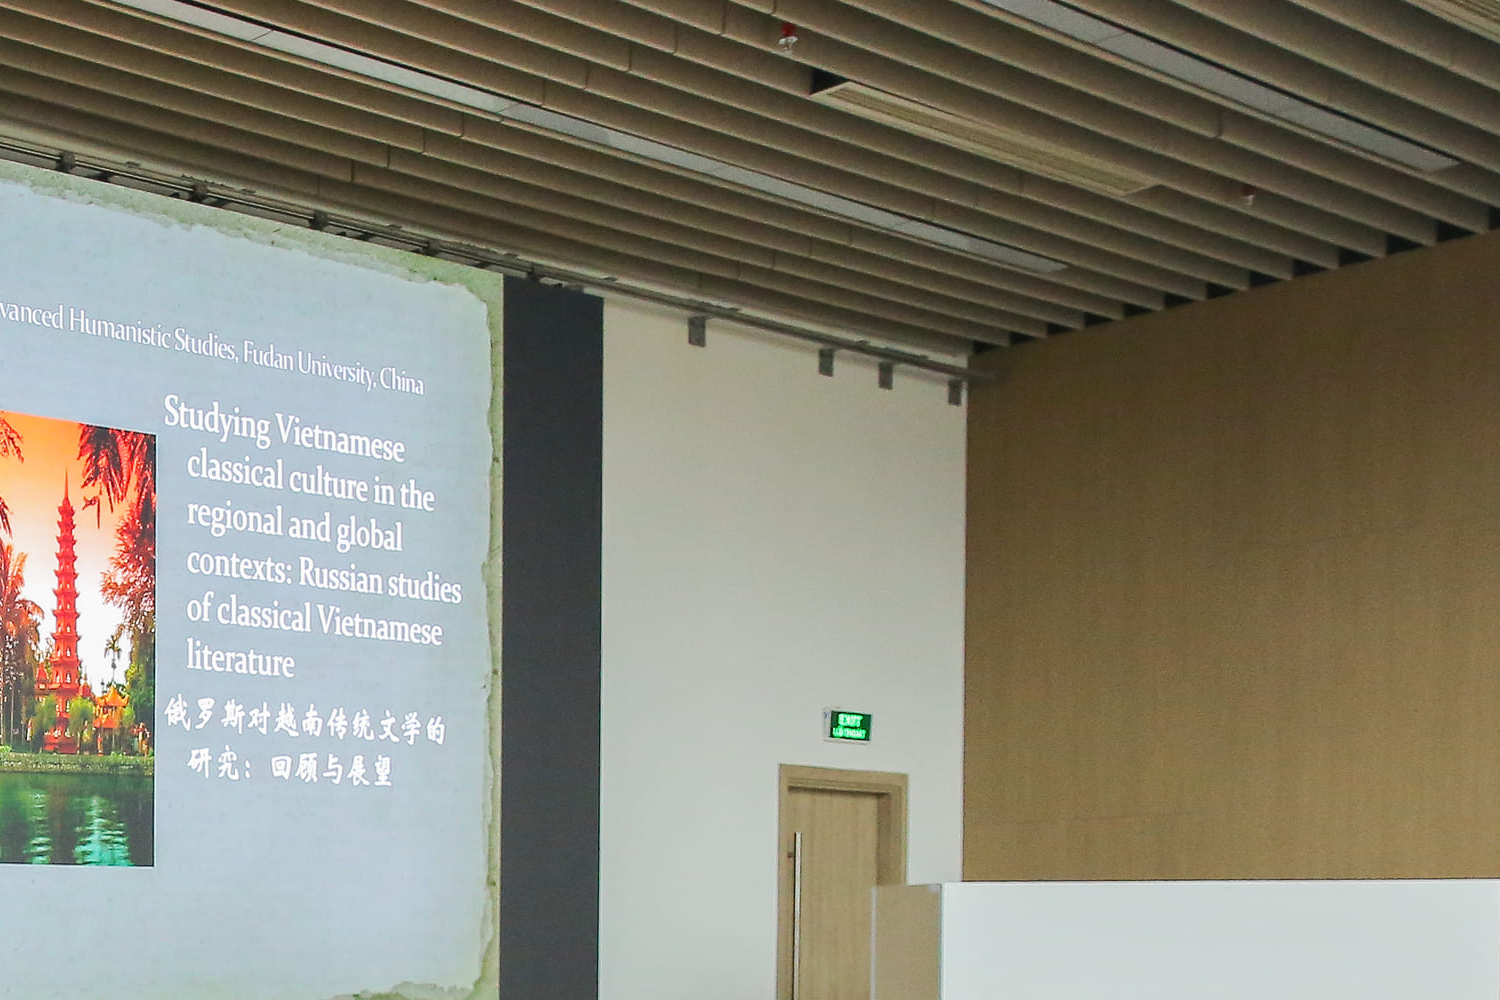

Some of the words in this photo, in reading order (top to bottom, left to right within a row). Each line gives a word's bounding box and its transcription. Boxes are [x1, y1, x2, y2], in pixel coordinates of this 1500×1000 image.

[68, 307, 172, 350] Humanistic
[174, 327, 240, 364] Studies,
[242, 340, 295, 372] Fudan
[297, 350, 378, 392] University,
[379, 366, 425, 396] China
[163, 393, 272, 450] Studying
[275, 412, 406, 463] Vietnamese
[186, 446, 284, 490] classical
[288, 464, 369, 503] culture
[372, 475, 396, 507] in
[399, 478, 436, 513] the
[186, 499, 284, 537] regional
[288, 511, 332, 544] and
[336, 515, 404, 553] global
[186, 552, 293, 586] contexts:
[297, 556, 384, 596] Russian
[387, 571, 463, 605] studies
[186, 590, 215, 622] of
[216, 593, 312, 634] classical
[314, 603, 444, 647] Vietnamese
[186, 637, 296, 678] literature
[162, 692, 446, 747] 俄罗斯对越南传统文学的
